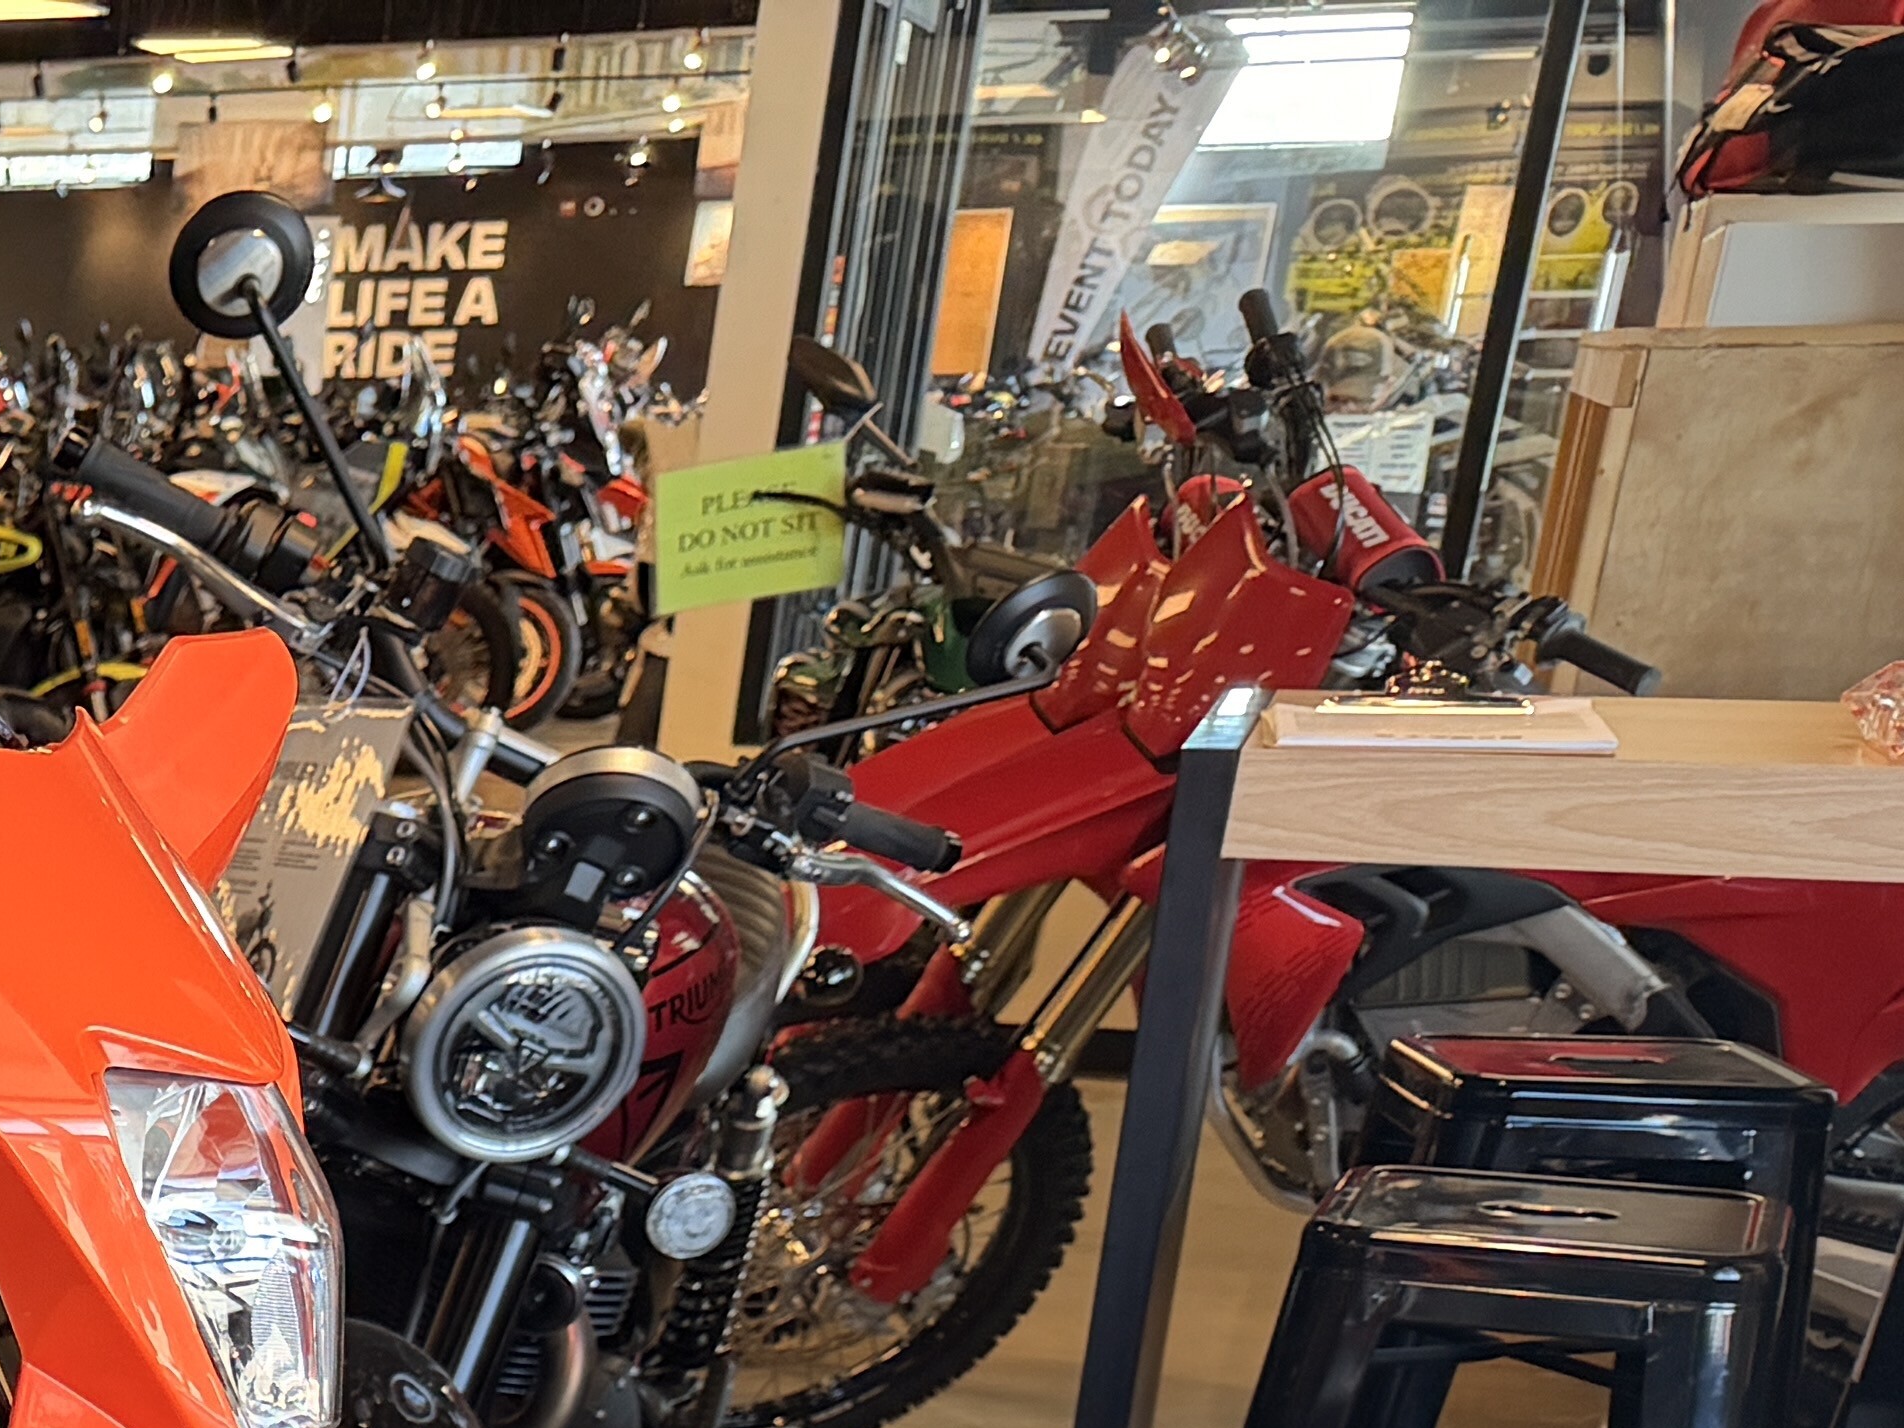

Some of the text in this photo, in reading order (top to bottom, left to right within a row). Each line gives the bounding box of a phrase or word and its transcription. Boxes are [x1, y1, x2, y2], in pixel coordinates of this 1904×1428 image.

[332, 220, 509, 274] MAKE
[1044, 90, 1180, 362] EVENT TODAY
[327, 276, 499, 328] LIFE A
[322, 328, 459, 380] RIDE
[701, 480, 798, 516] PLE
[677, 511, 820, 553] DO NOT SIT
